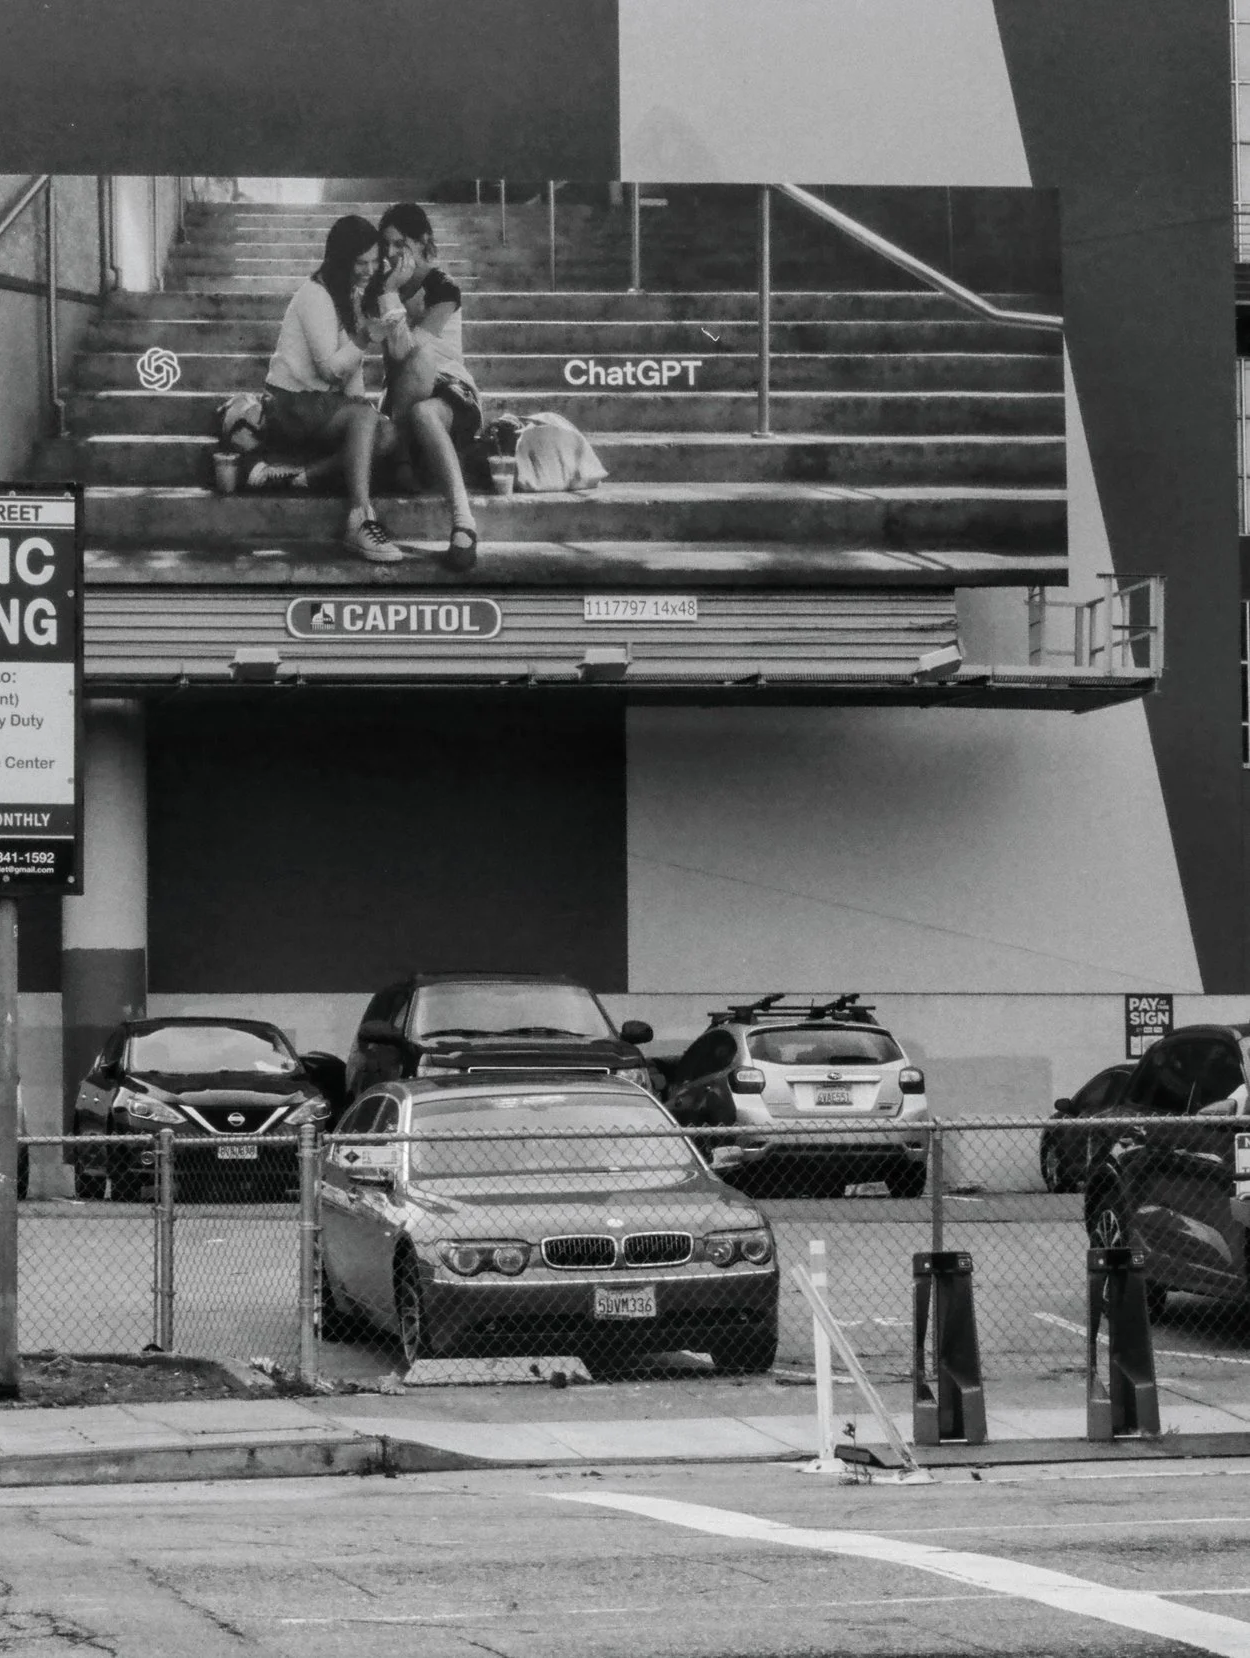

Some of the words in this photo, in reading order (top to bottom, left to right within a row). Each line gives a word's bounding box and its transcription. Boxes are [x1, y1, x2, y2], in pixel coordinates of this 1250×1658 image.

[565, 358, 702, 388] ChatGPT
[586, 600, 647, 617] 1117797
[653, 600, 696, 617] 14x48
[343, 605, 480, 632] CAPITOL
[11, 714, 44, 730] Duty
[5, 756, 55, 770] Center
[1129, 997, 1159, 1011] PAY
[1130, 1011, 1169, 1025] SIGN
